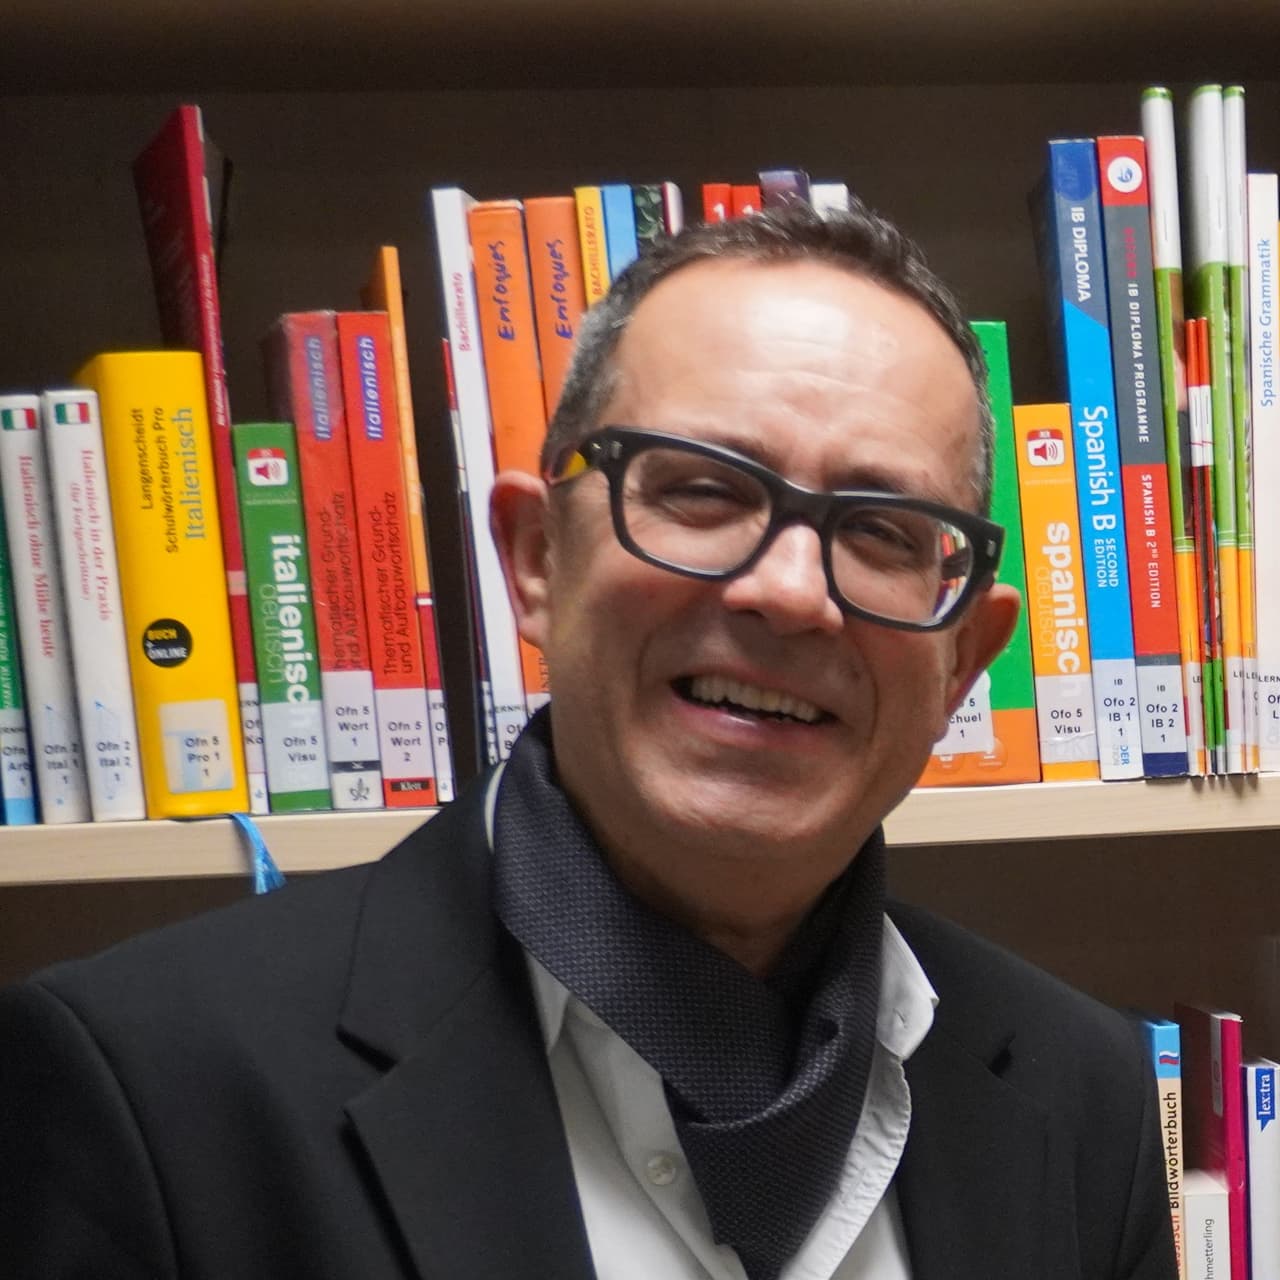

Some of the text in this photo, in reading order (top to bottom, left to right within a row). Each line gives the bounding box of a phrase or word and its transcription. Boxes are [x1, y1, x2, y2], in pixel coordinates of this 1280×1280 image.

[486, 239, 516, 341] Enfoques
[544, 239, 573, 341] Enfoques
[1070, 206, 1092, 303] IB DIPLOMA
[1128, 301, 1152, 444] DIPLOMA PROGRAMME
[1257, 238, 1275, 407] Spanische Grammatik
[304, 335, 332, 441] Italienisch
[357, 335, 385, 441] Italienisch
[19, 456, 42, 530] Italienisch
[81, 450, 103, 524] Italienisch
[131, 408, 154, 510] Langenscheidt
[155, 435, 179, 554] Schulwörterbuch
[172, 407, 206, 541] Italienisch
[1081, 405, 1117, 531] Spanish B
[319, 505, 338, 562] Grund-
[331, 491, 361, 639] Aufbauwortschatz
[1093, 538, 1107, 589] EDITION
[1105, 537, 1119, 588] SECOND
[1140, 473, 1161, 609] SPANISH EDITION
[259, 583, 286, 685] deutsch
[368, 505, 397, 676] Thematischer Grund-
[1054, 723, 1081, 734] Visu
[1103, 697, 1126, 708] Ofo
[1146, 704, 1168, 714] Ofo
[1163, 1091, 1178, 1209] Bildwörterbuch
